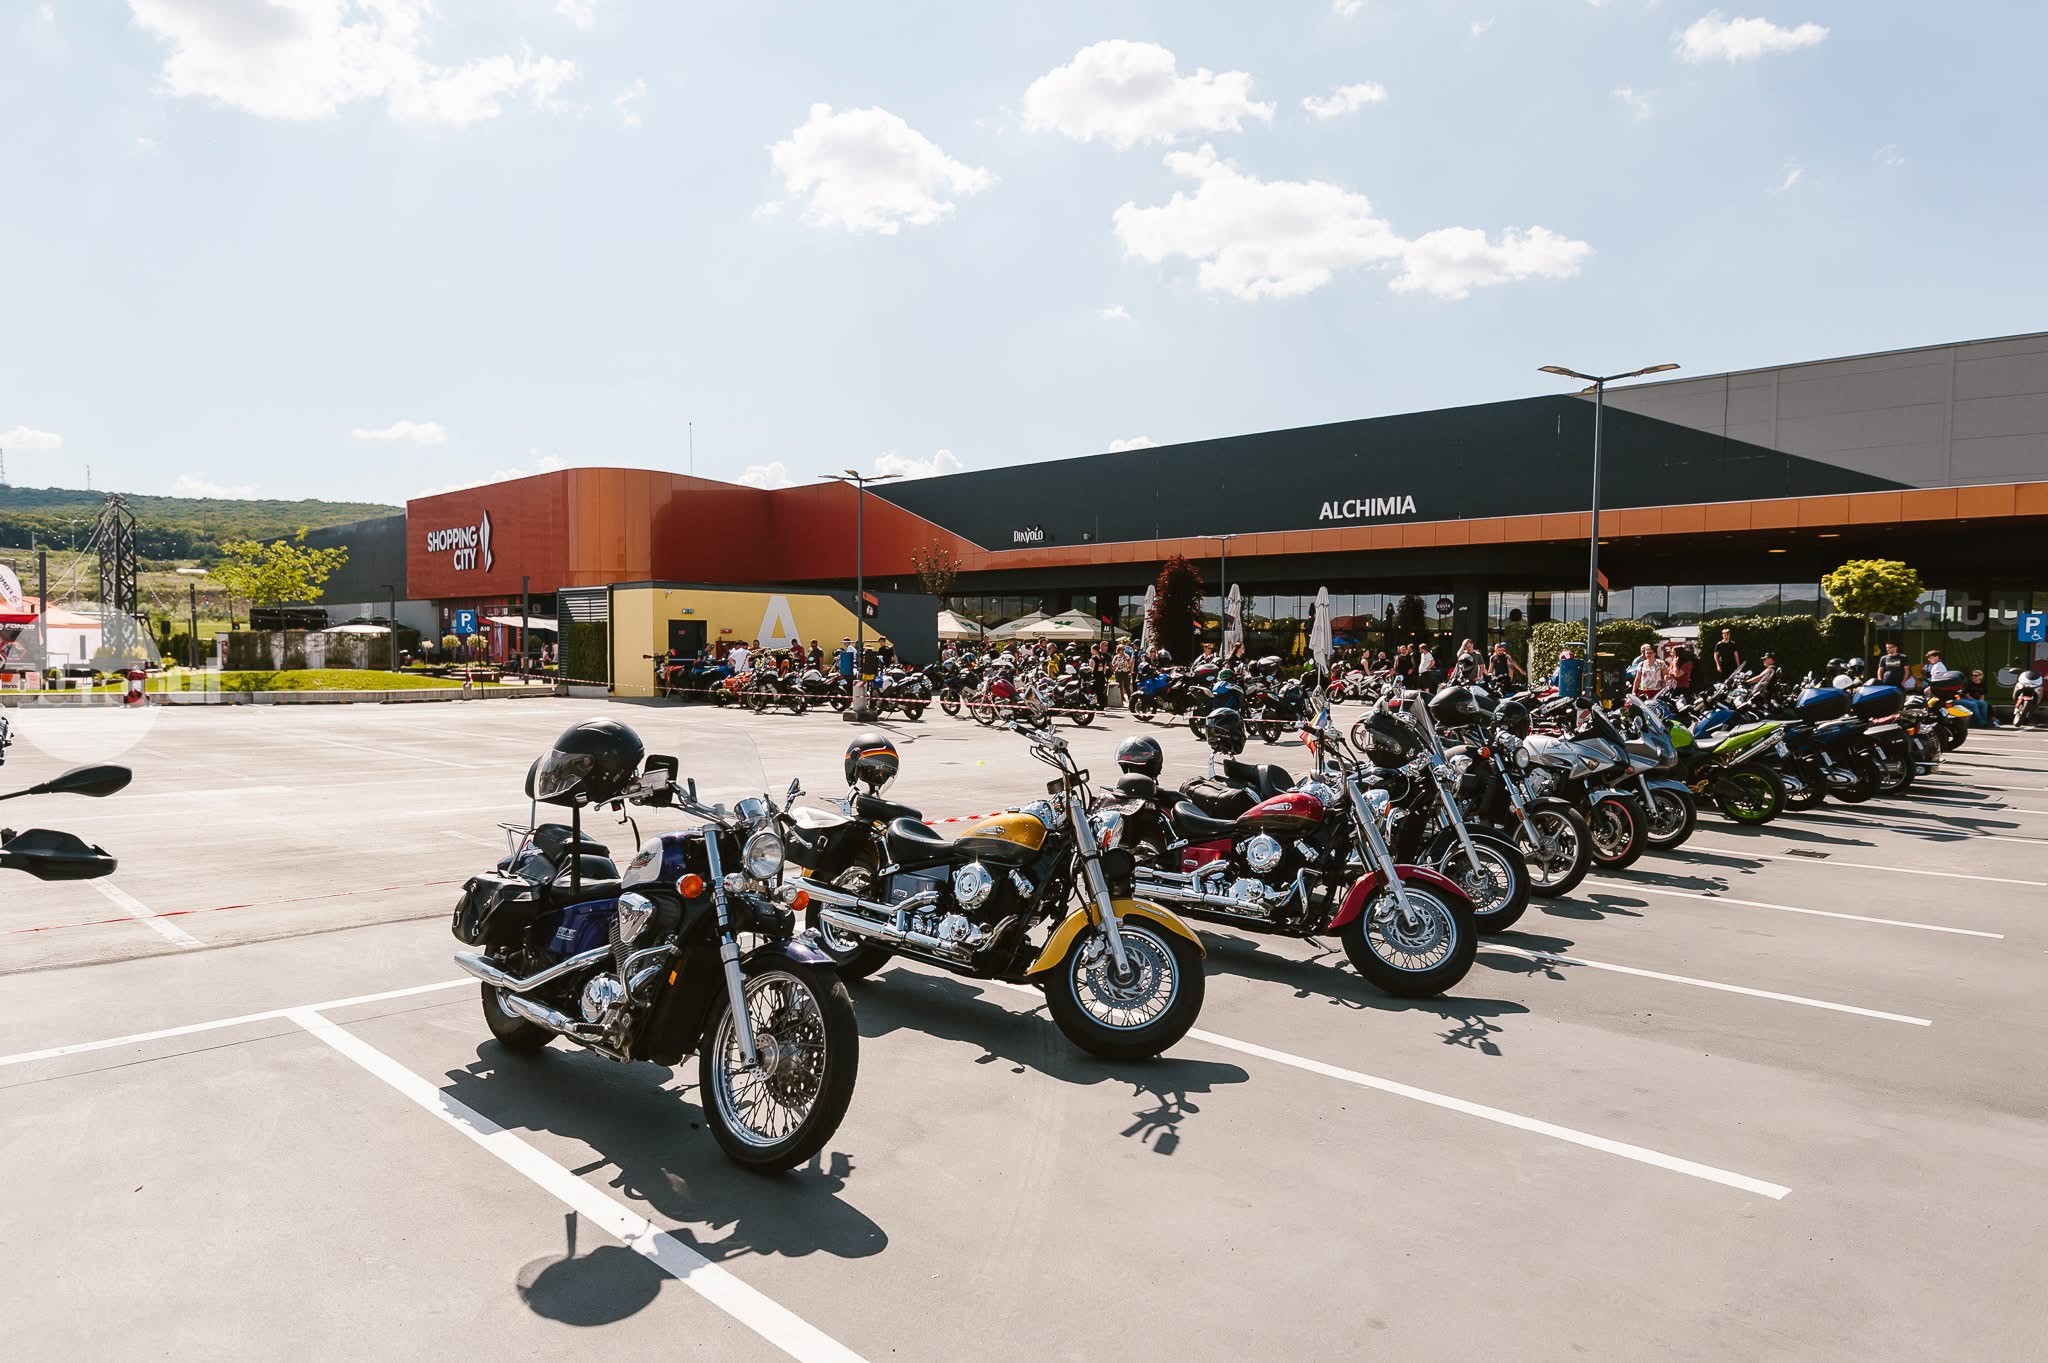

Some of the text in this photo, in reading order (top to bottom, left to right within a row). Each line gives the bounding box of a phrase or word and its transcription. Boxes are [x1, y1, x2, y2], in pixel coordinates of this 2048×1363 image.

[1319, 495, 1416, 520] ALCHIMIA
[427, 526, 478, 552] SHOPPING
[453, 548, 477, 571] CITY
[461, 613, 472, 627] P
[2025, 616, 2041, 633] P
